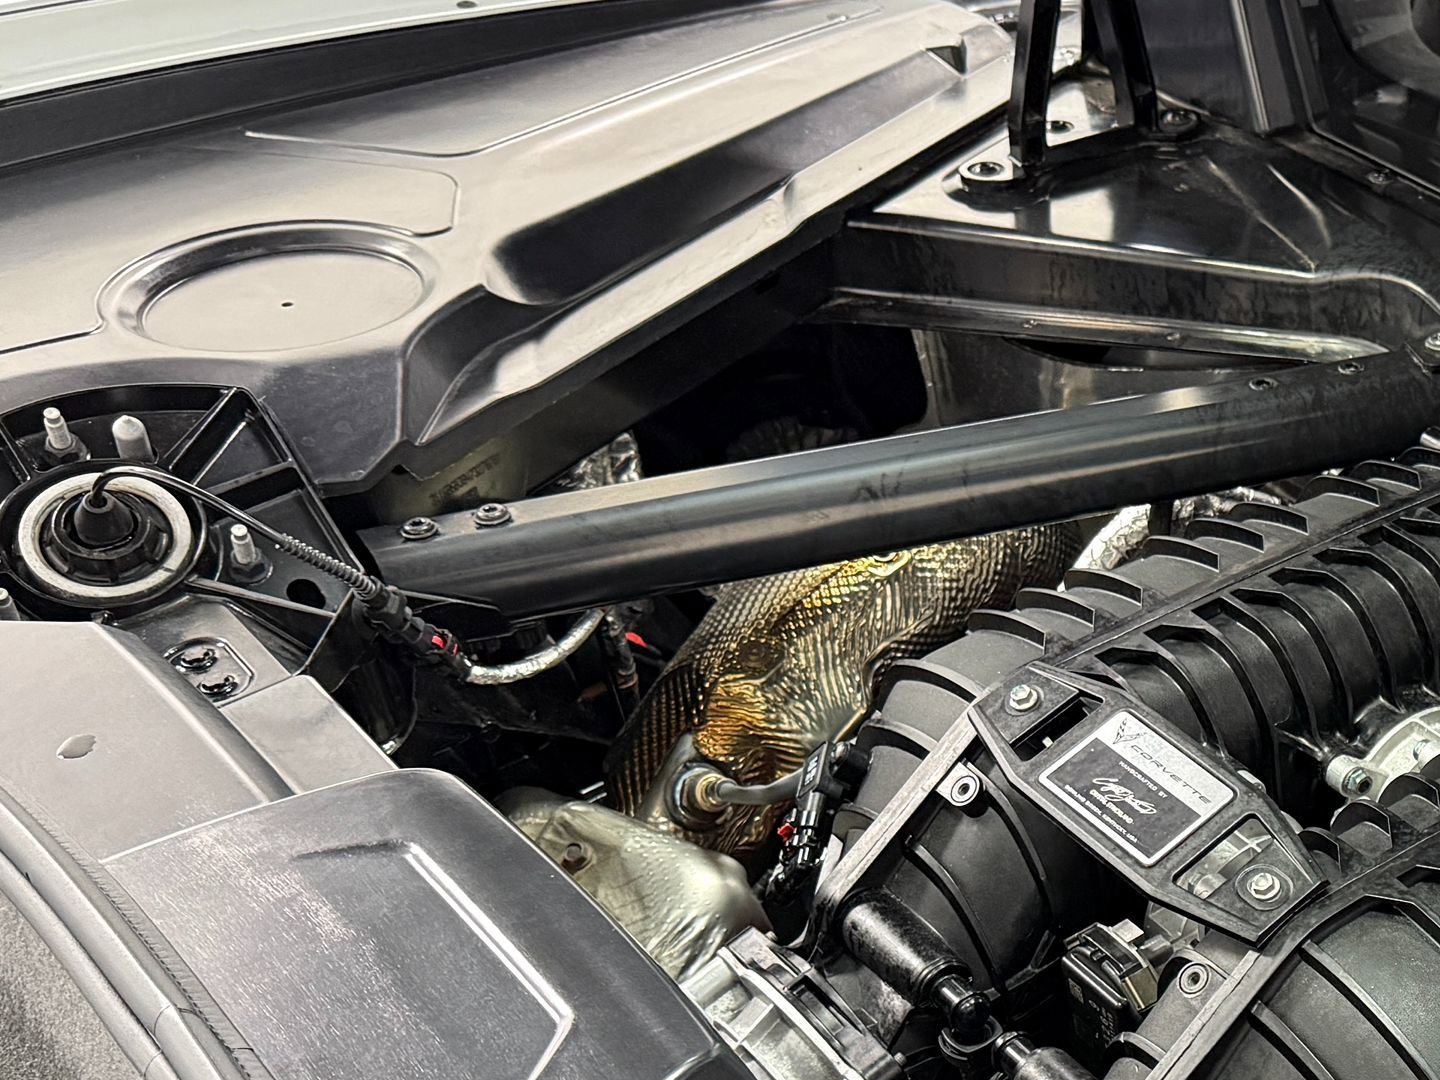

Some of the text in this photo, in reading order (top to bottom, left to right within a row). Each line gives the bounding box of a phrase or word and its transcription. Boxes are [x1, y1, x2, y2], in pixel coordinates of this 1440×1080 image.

[1118, 760, 1158, 792] HANDCRAFTED
[1157, 790, 1168, 799] BY
[1130, 744, 1212, 804] CORVETTE
